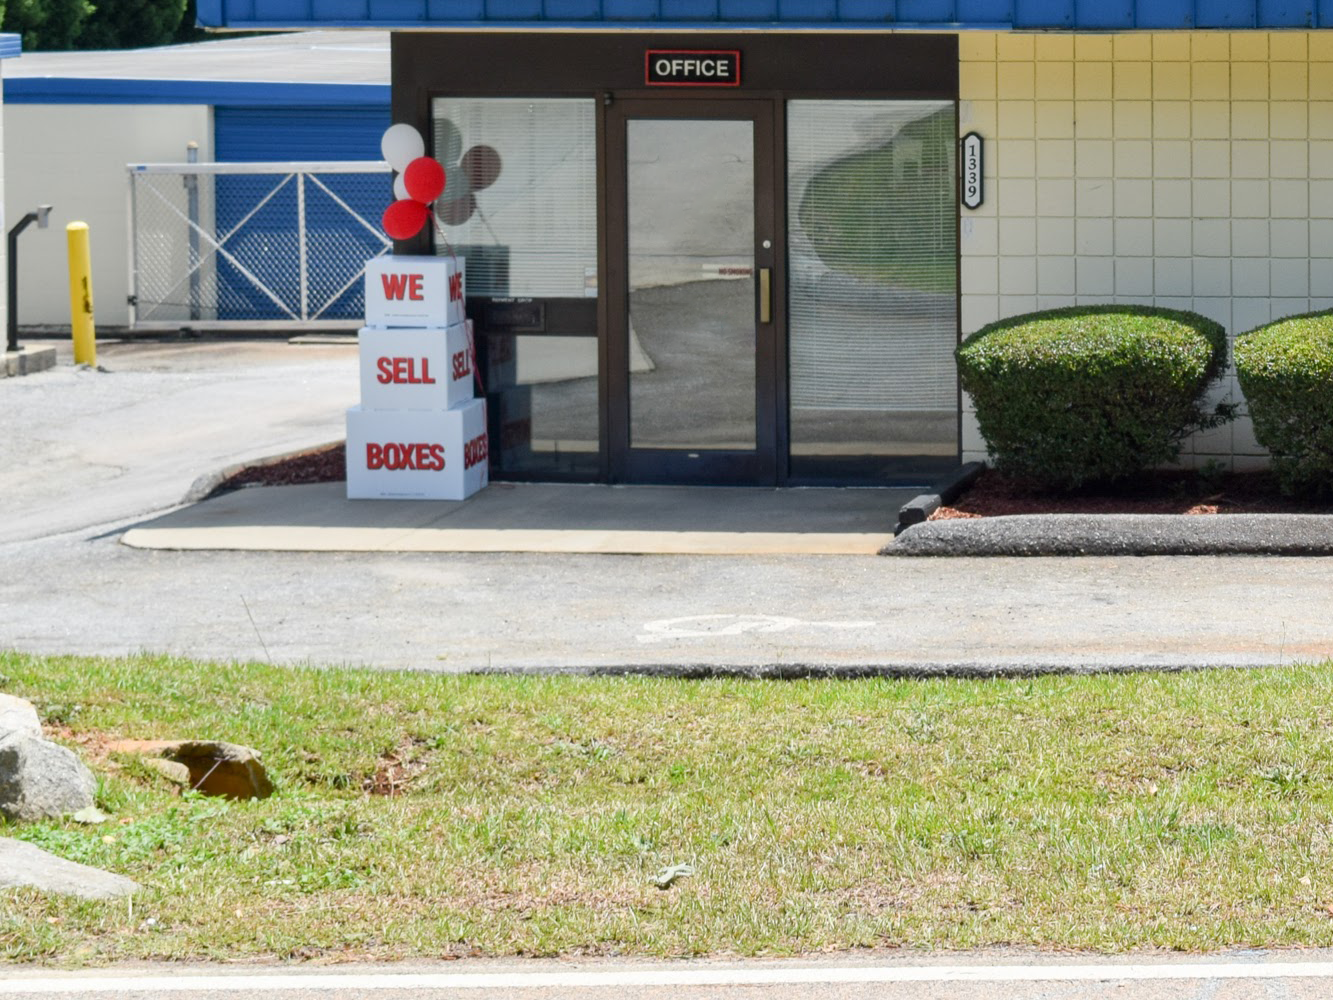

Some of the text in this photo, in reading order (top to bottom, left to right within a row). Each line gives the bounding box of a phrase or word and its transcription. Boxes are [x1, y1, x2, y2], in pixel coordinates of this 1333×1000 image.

[655, 59, 729, 77] OFFICE
[968, 144, 977, 198] 1339
[381, 273, 424, 301] WE
[448, 271, 462, 302] WE
[376, 356, 436, 384] SELL
[452, 348, 471, 382] SELL
[366, 442, 445, 471] BOXES
[464, 432, 488, 471] BOXES
